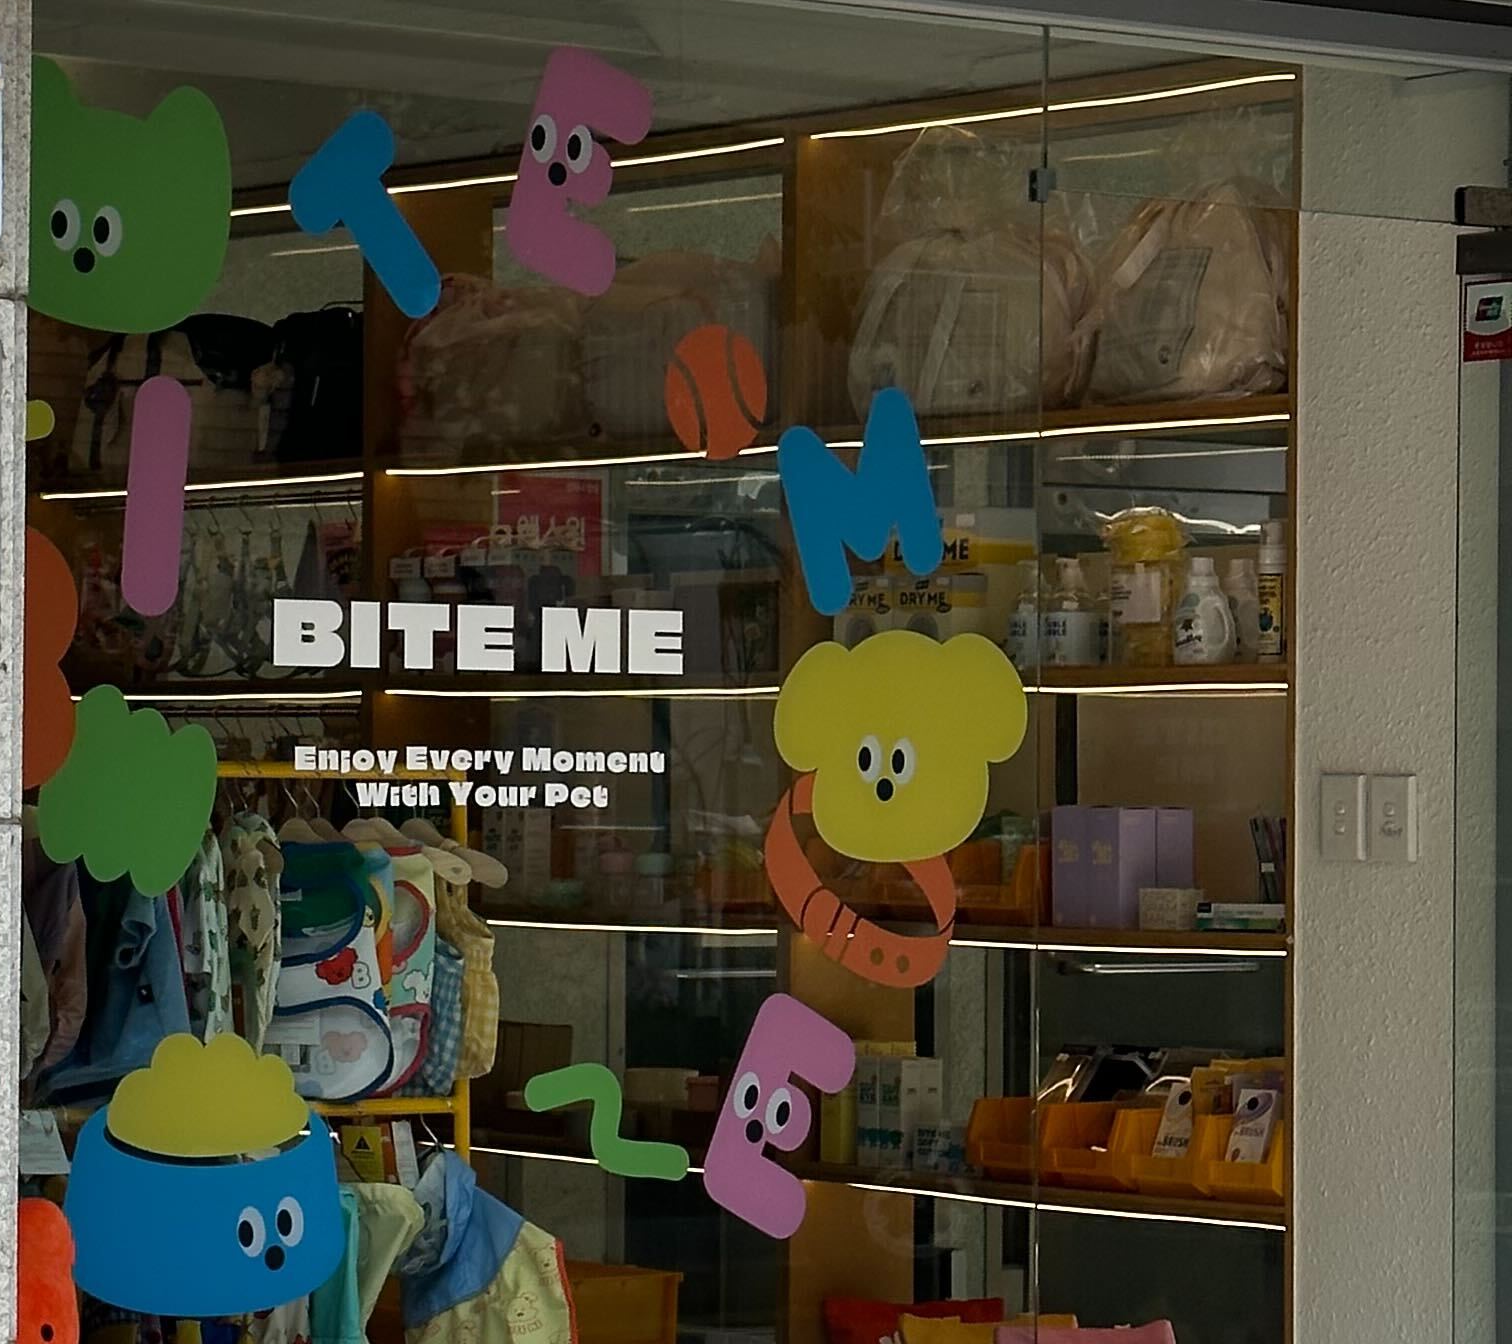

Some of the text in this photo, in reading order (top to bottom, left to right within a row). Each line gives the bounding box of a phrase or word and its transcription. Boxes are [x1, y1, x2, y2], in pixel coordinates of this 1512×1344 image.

[273, 598, 684, 675] BITE ME
[294, 745, 665, 775] Enjoy Every Moment
[356, 782, 608, 808] With Your Pet
